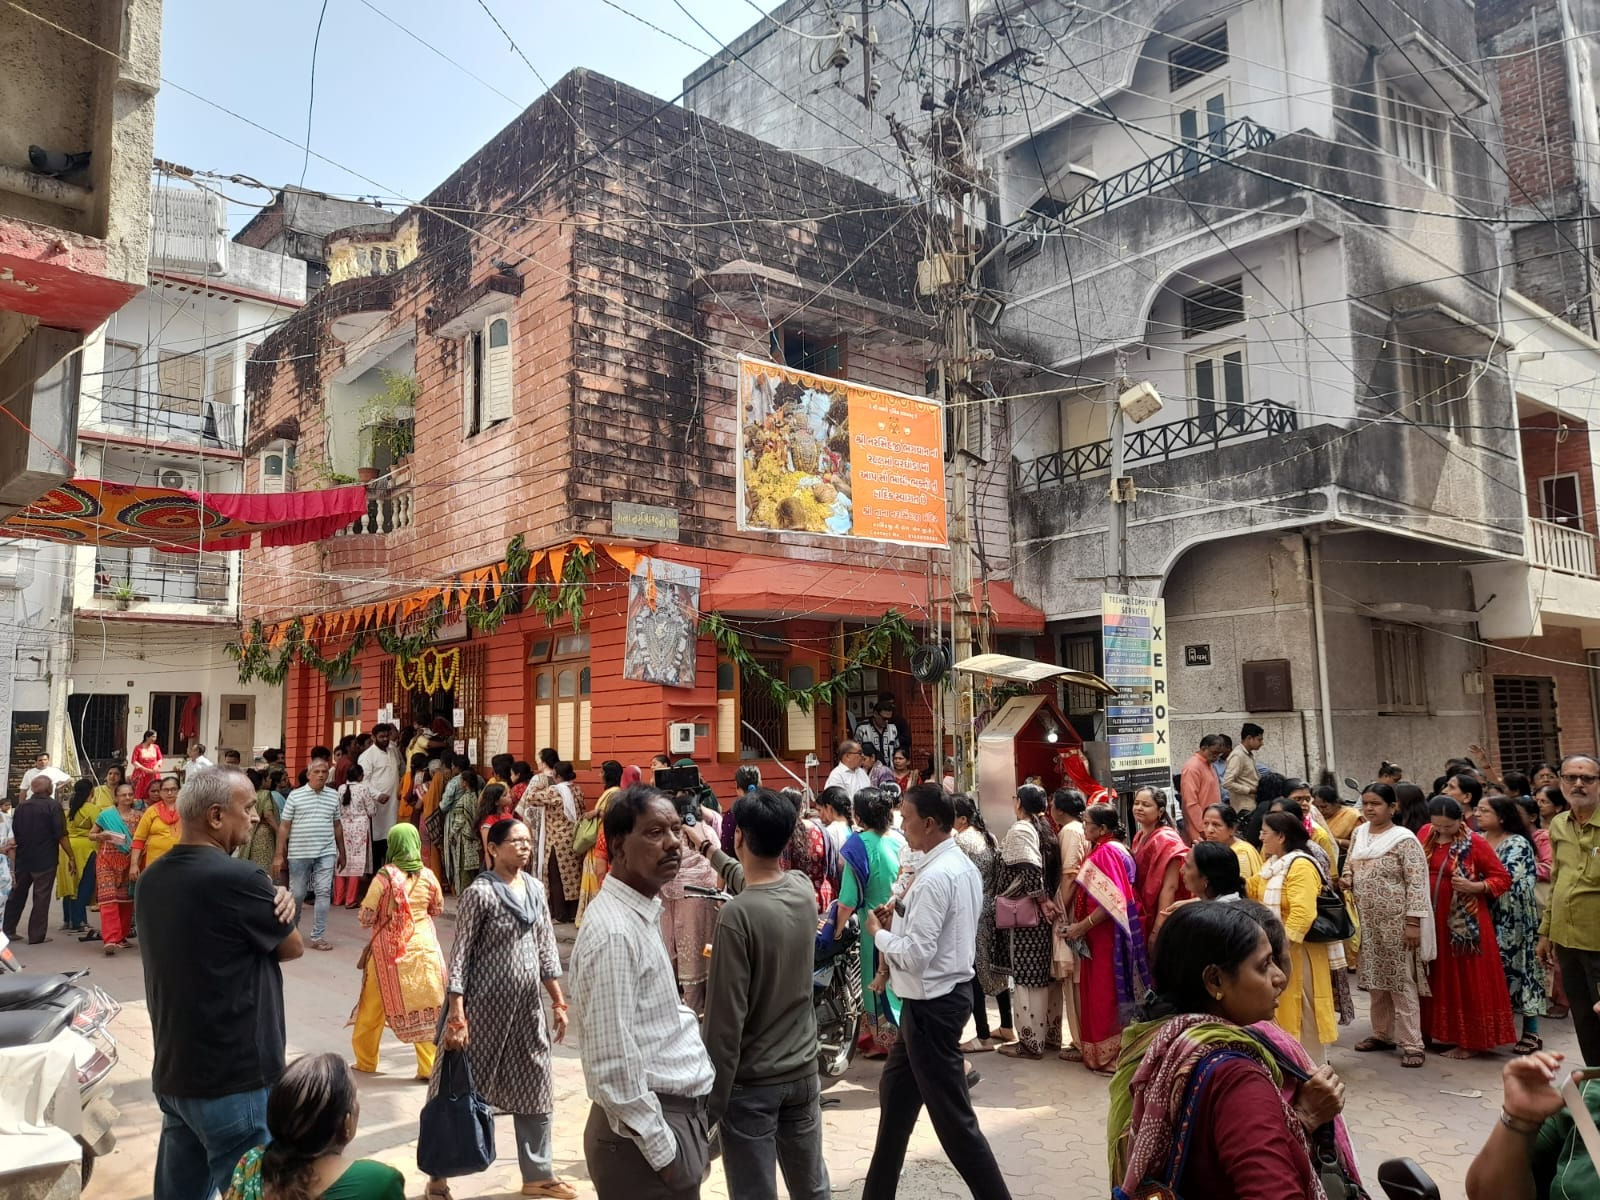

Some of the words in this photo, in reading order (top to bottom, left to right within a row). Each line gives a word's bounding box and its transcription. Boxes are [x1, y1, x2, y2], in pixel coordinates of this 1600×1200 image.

[1131, 597, 1158, 607] COMPUTER
[1121, 606, 1147, 616] SERVICES
[1152, 626, 1166, 744] XEROX
